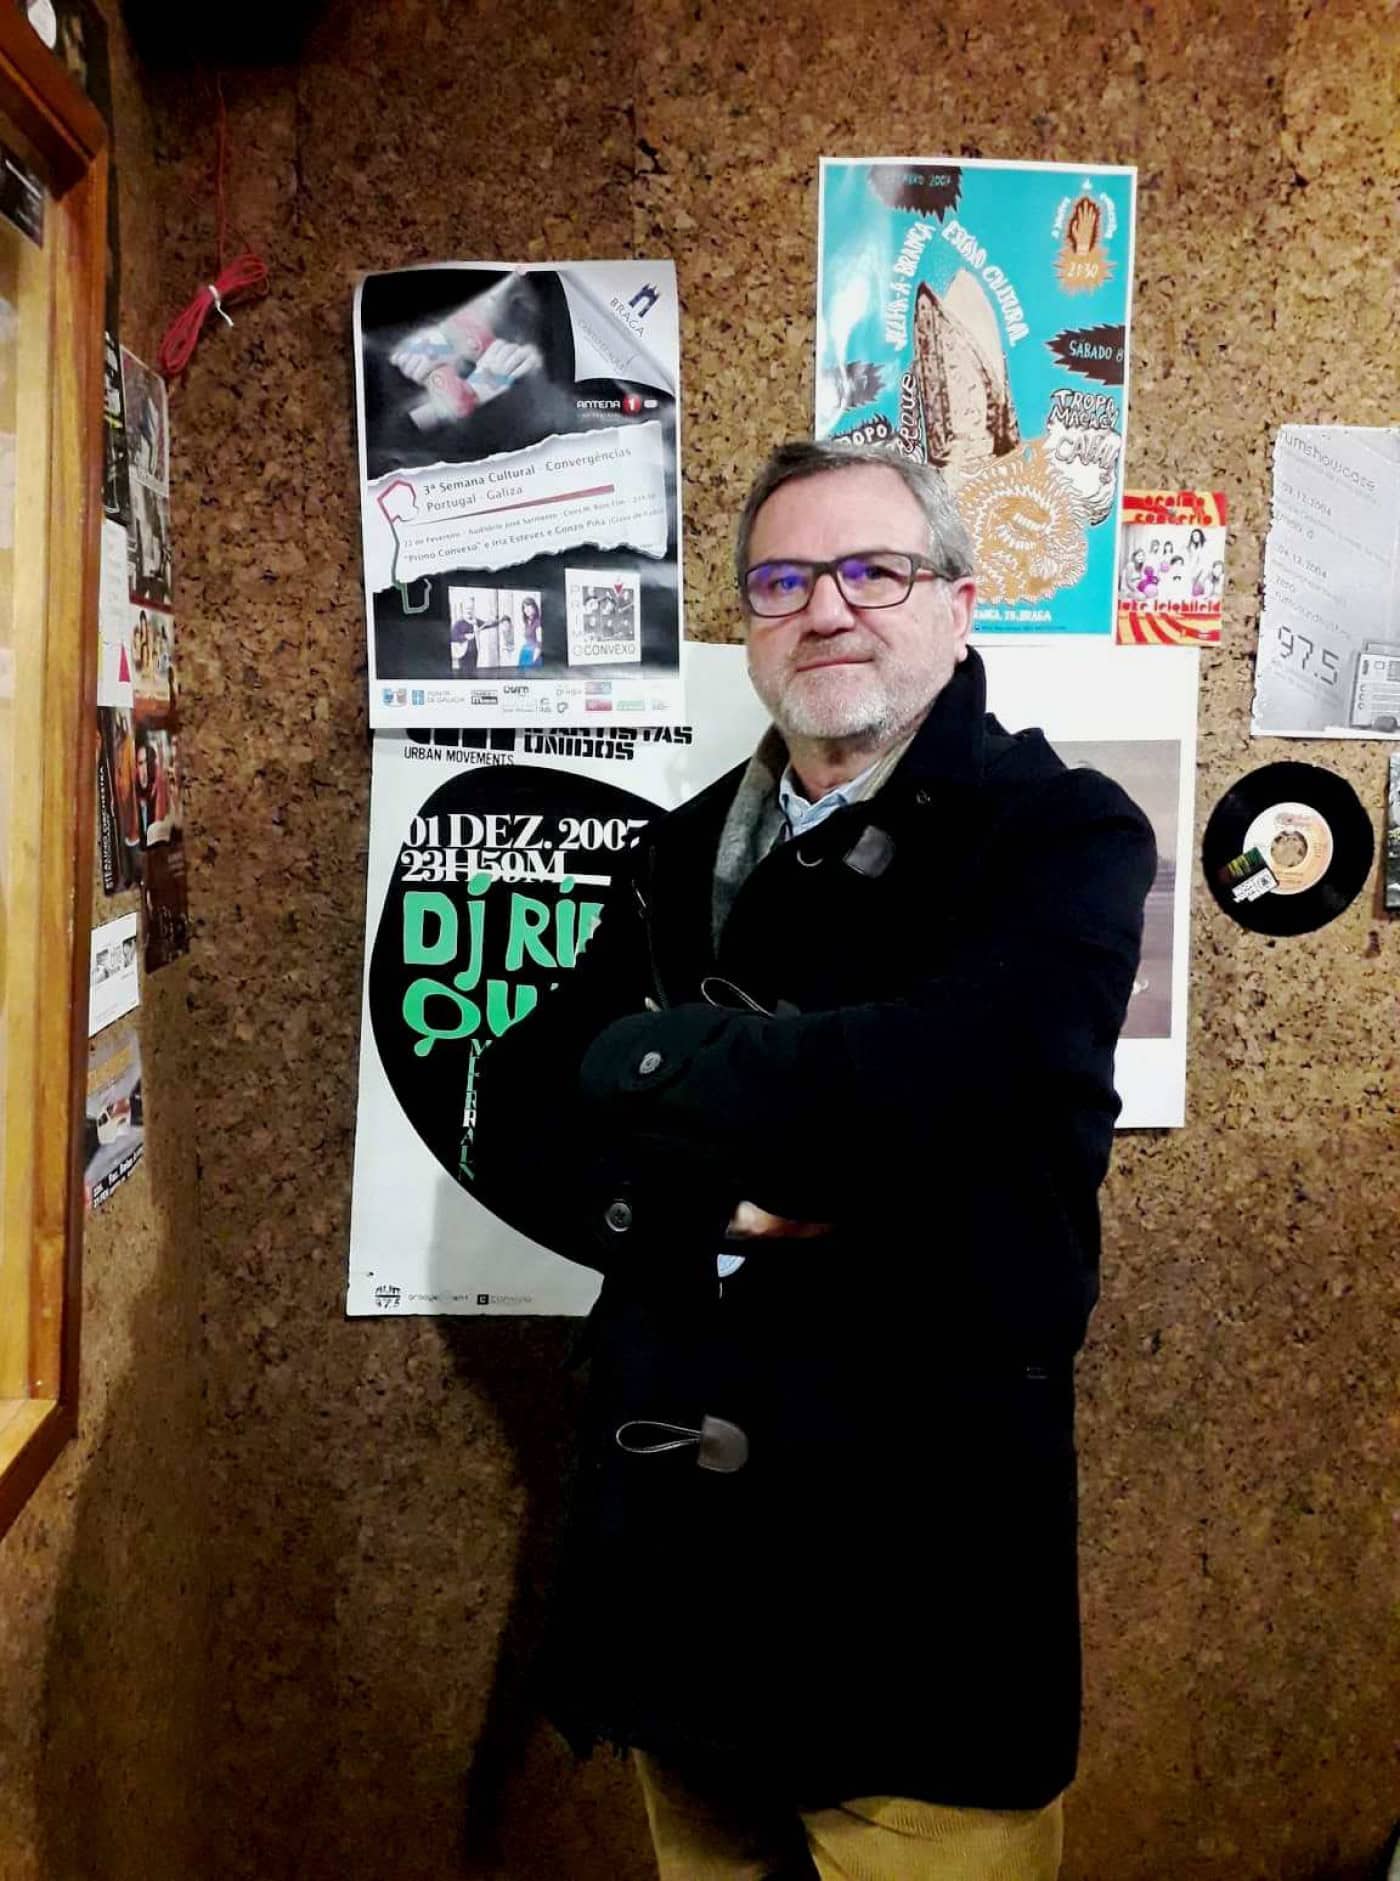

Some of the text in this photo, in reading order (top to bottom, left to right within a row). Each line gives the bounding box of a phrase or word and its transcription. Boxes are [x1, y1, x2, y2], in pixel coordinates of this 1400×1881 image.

[609, 296, 645, 337] BRAGA
[577, 400, 620, 409] ANTENA
[440, 476, 485, 493] Semana
[488, 465, 535, 483] Cultural
[546, 446, 632, 472] Convergências
[426, 485, 523, 512] Portugal Galiza
[1278, 625, 1339, 686] 97.5
[404, 745, 515, 767] URBAN MOVEMENTS
[524, 735, 634, 761] UNIDOS
[402, 813, 649, 850] 01 DEZ. 2007
